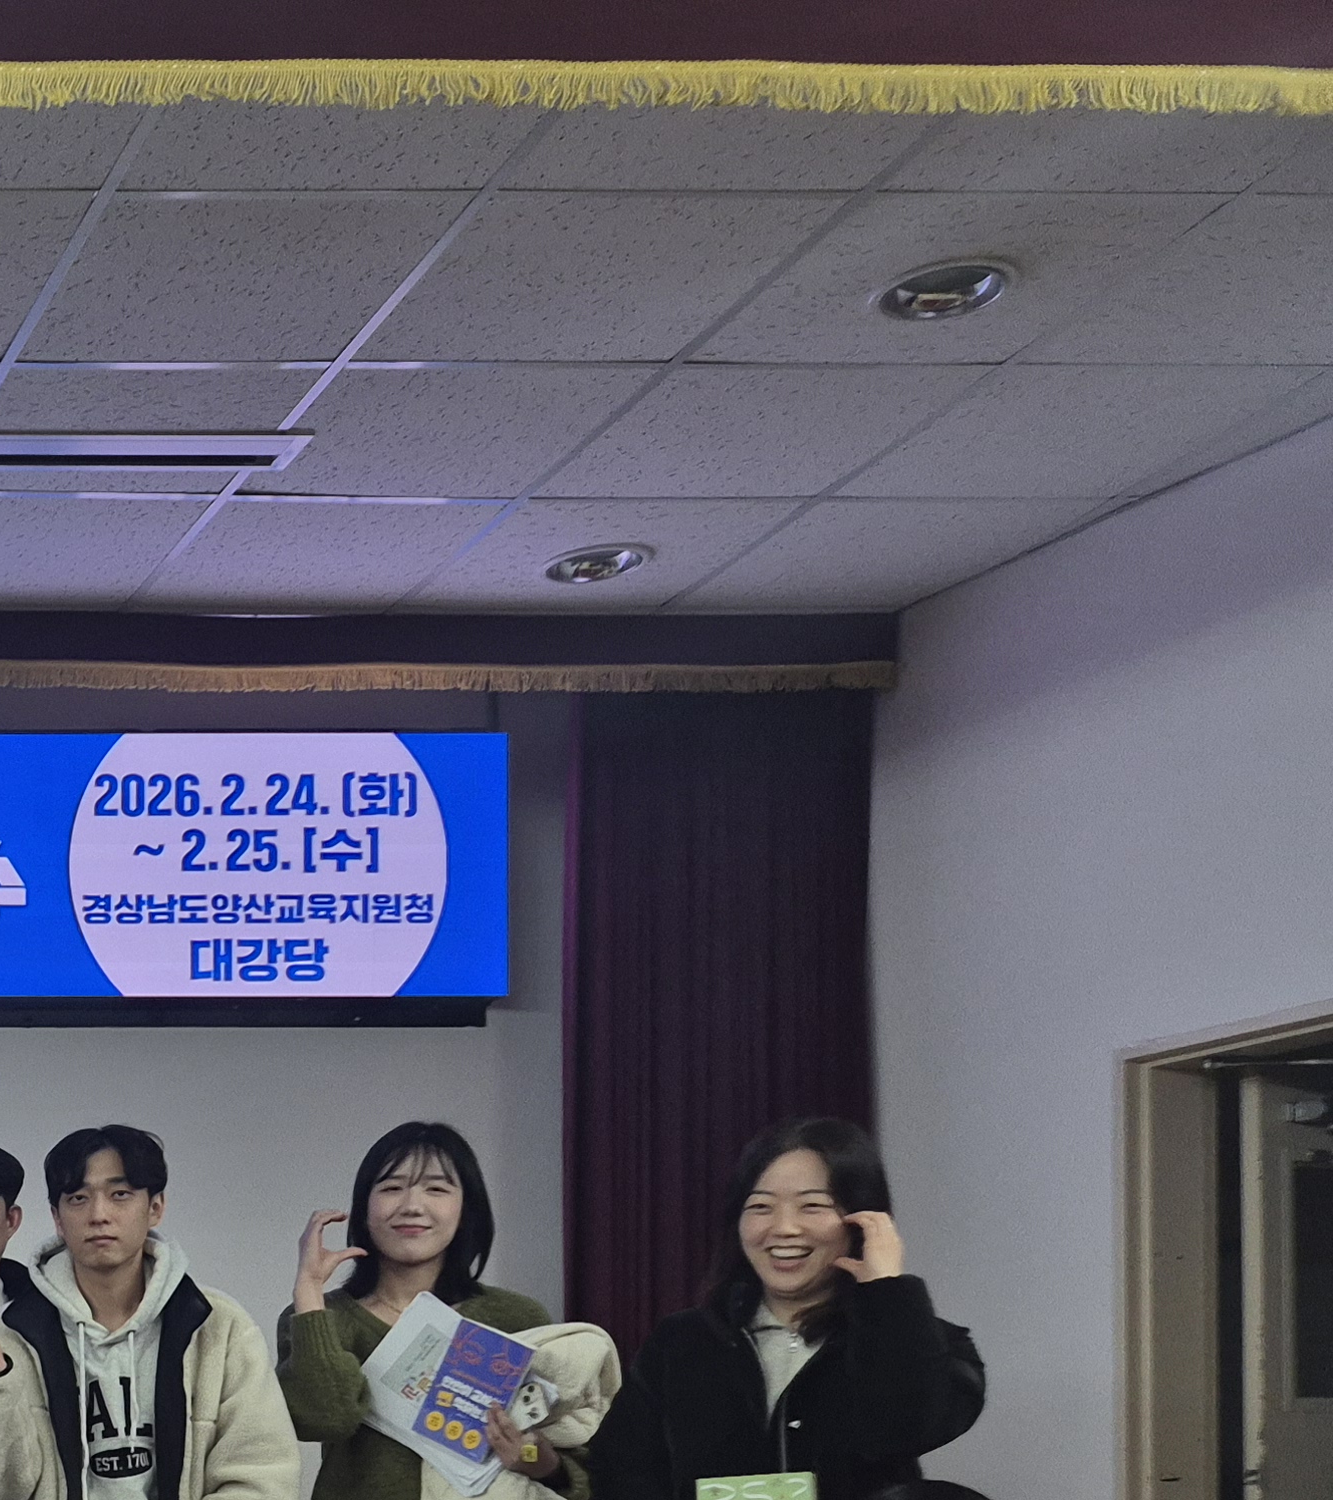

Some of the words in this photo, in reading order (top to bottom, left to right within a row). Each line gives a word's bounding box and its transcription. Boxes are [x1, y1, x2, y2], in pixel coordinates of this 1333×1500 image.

[82, 893, 434, 925] 경상남도양산교육지원청
[190, 938, 330, 982] 대강당
[95, 1456, 123, 1472] EST.
